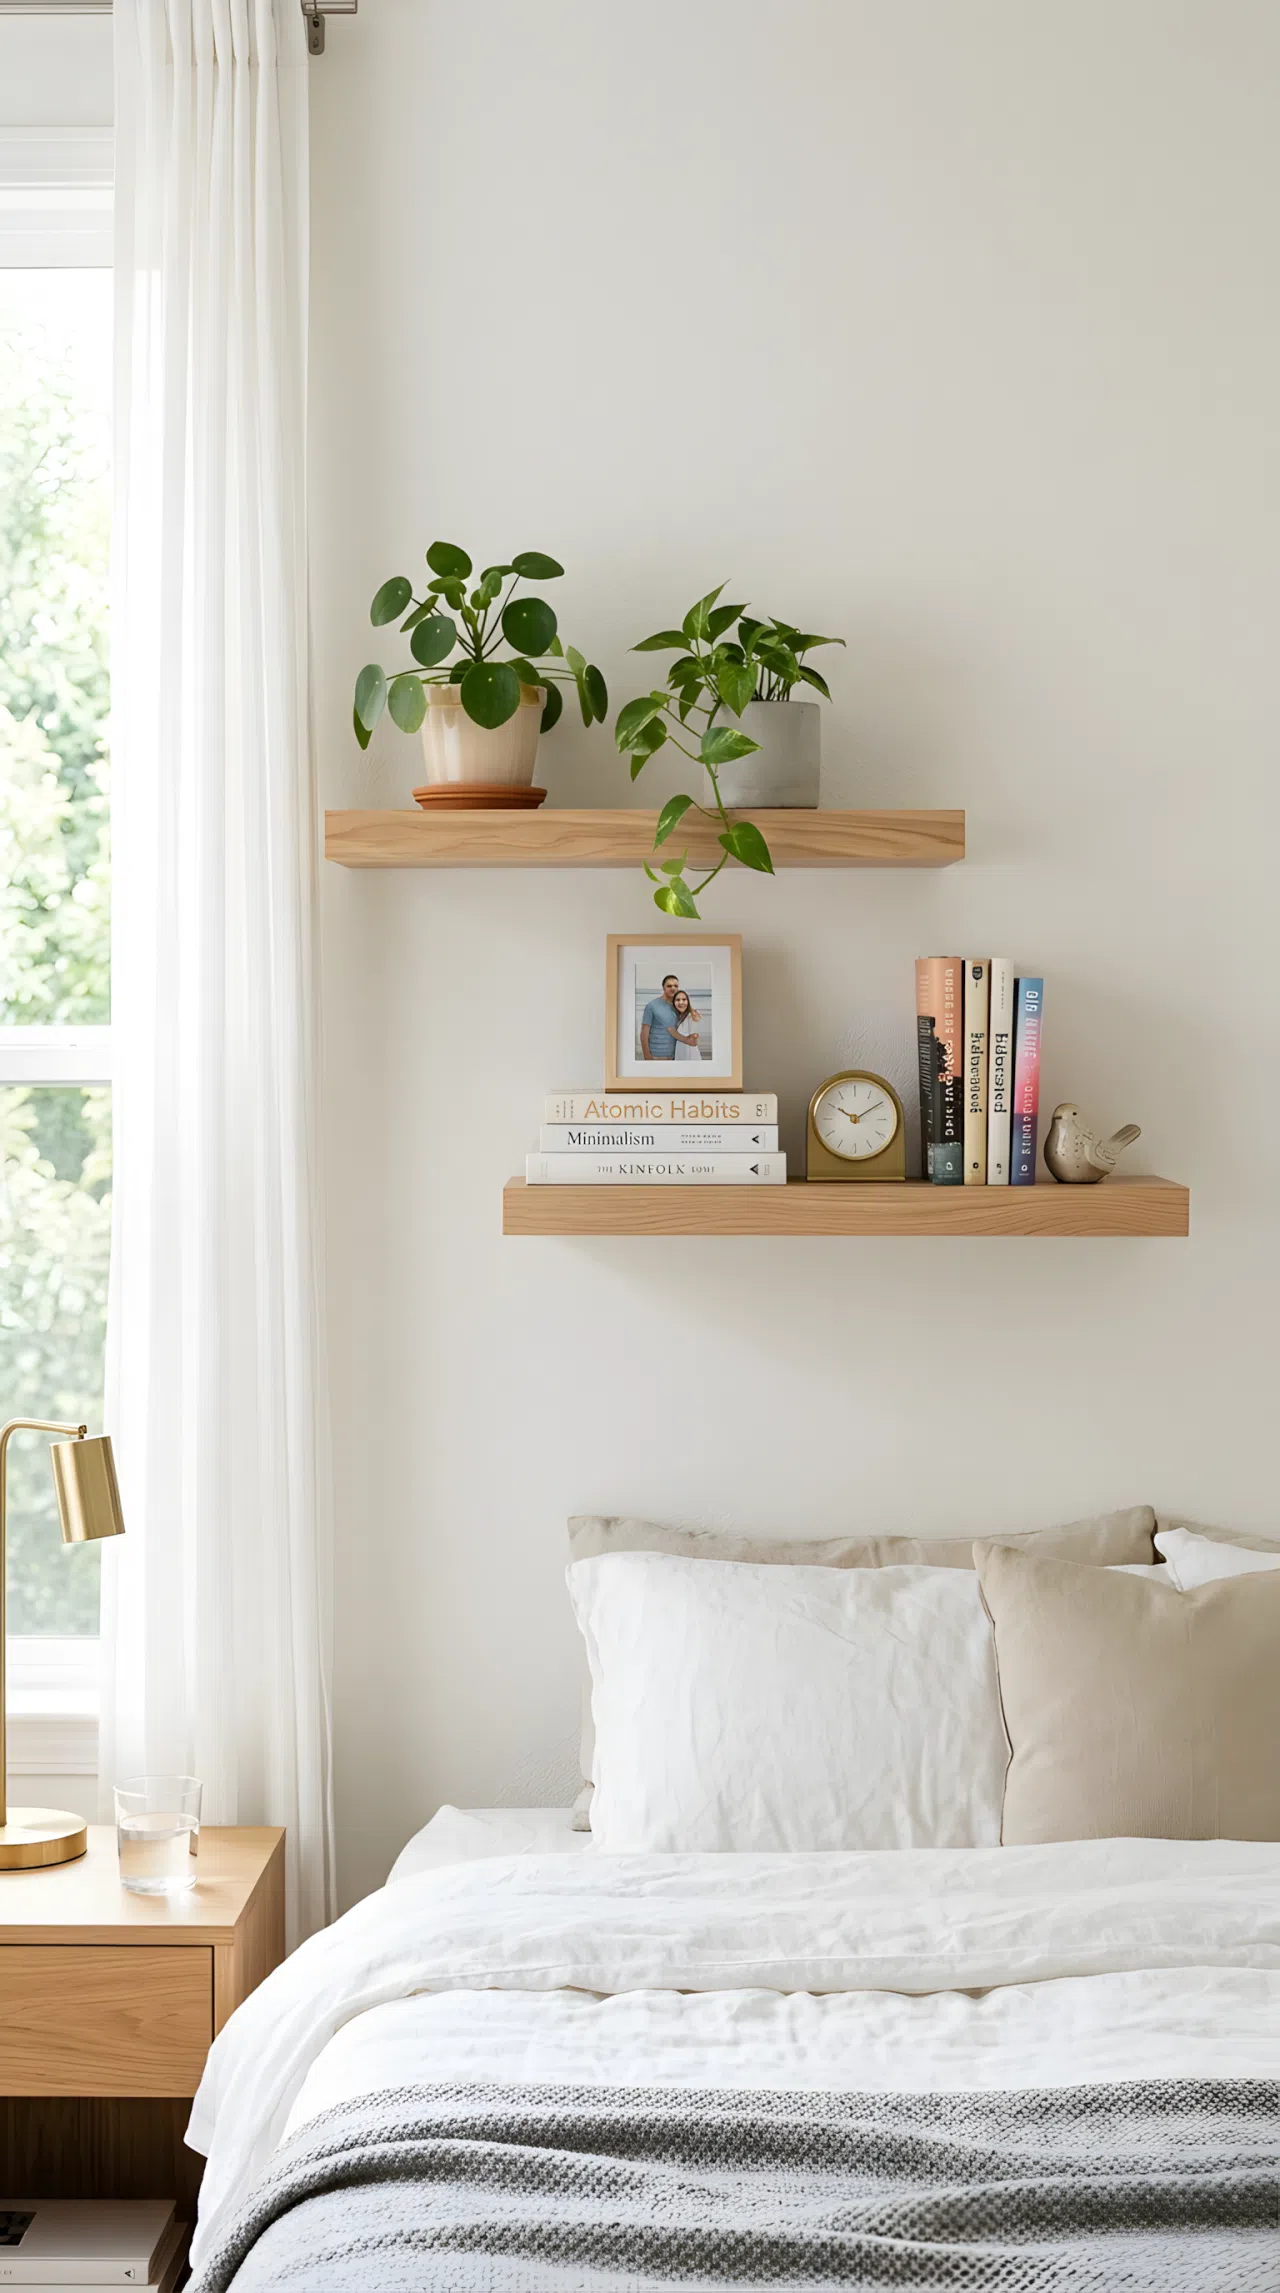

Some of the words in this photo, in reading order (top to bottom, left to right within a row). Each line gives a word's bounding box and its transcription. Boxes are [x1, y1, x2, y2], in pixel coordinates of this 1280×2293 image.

[583, 1099, 663, 1119] Atomic
[670, 1099, 740, 1119] Habits
[567, 1131, 655, 1145] Minimalism
[619, 1164, 686, 1175] KINFOLK
